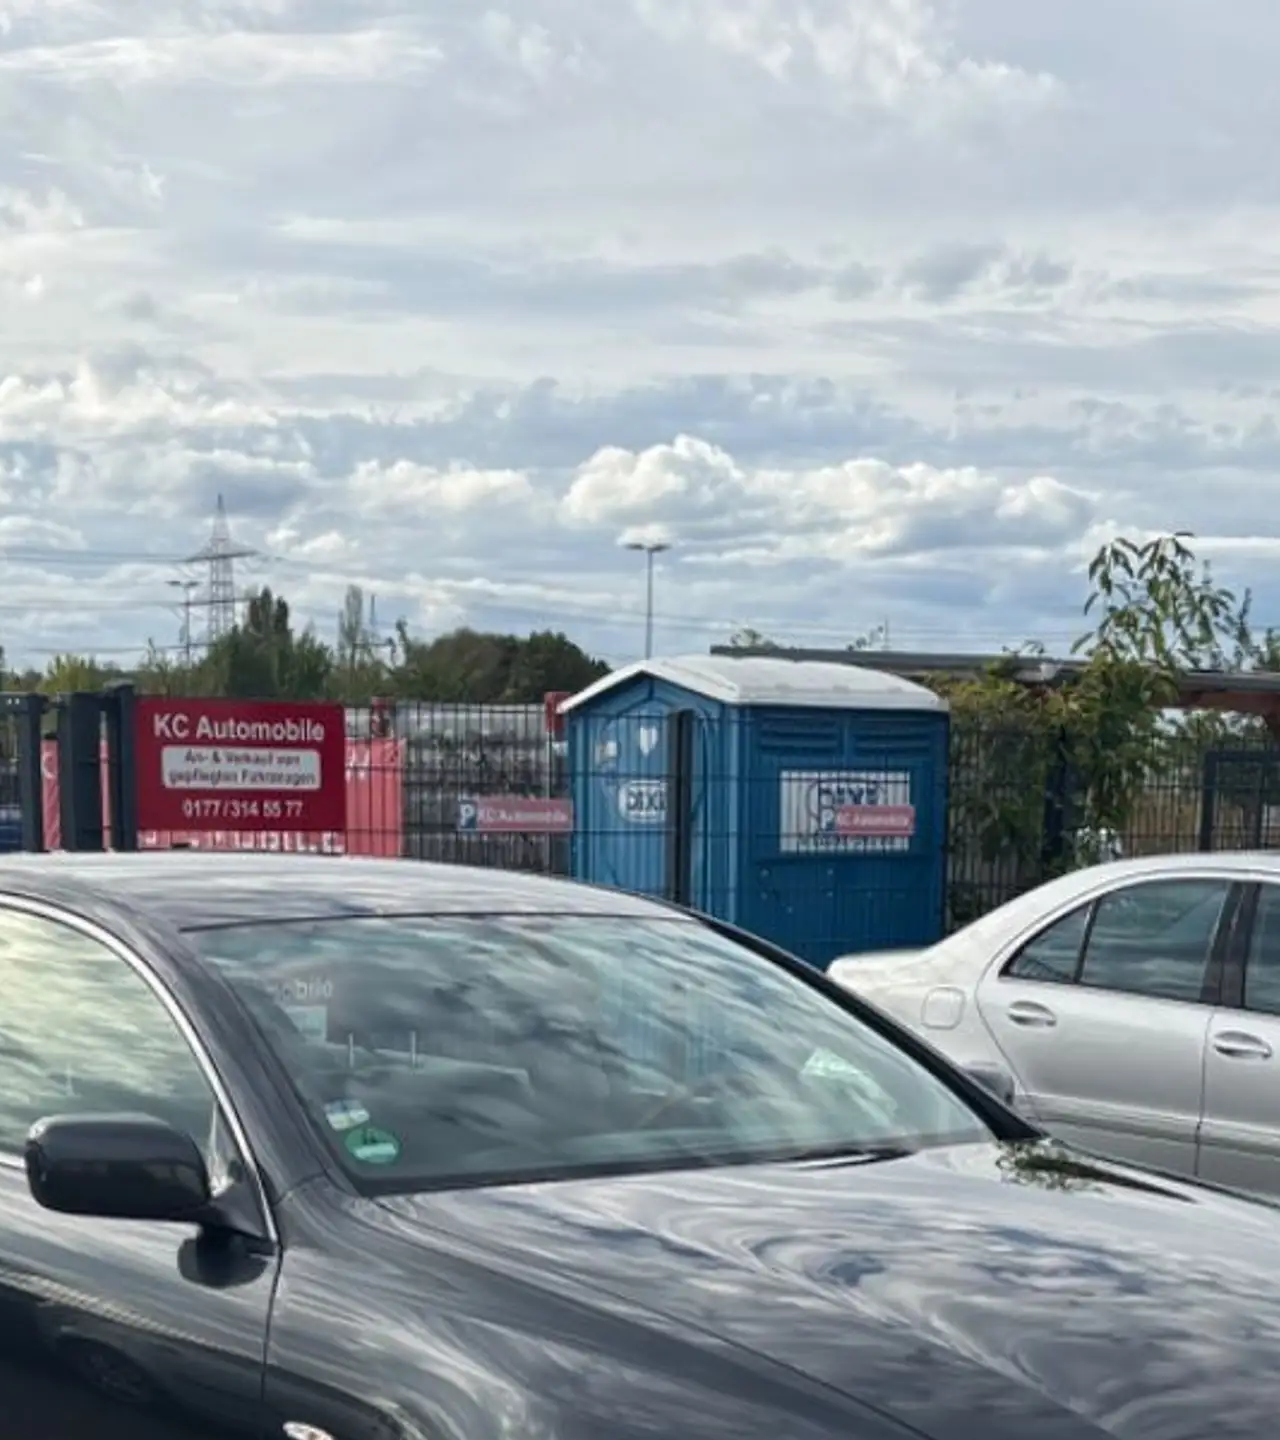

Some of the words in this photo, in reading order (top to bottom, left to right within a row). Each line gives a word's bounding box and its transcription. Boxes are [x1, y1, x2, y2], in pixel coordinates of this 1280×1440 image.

[153, 712, 190, 738] KC
[195, 714, 325, 742] Automobile
[284, 801, 303, 817] 77
